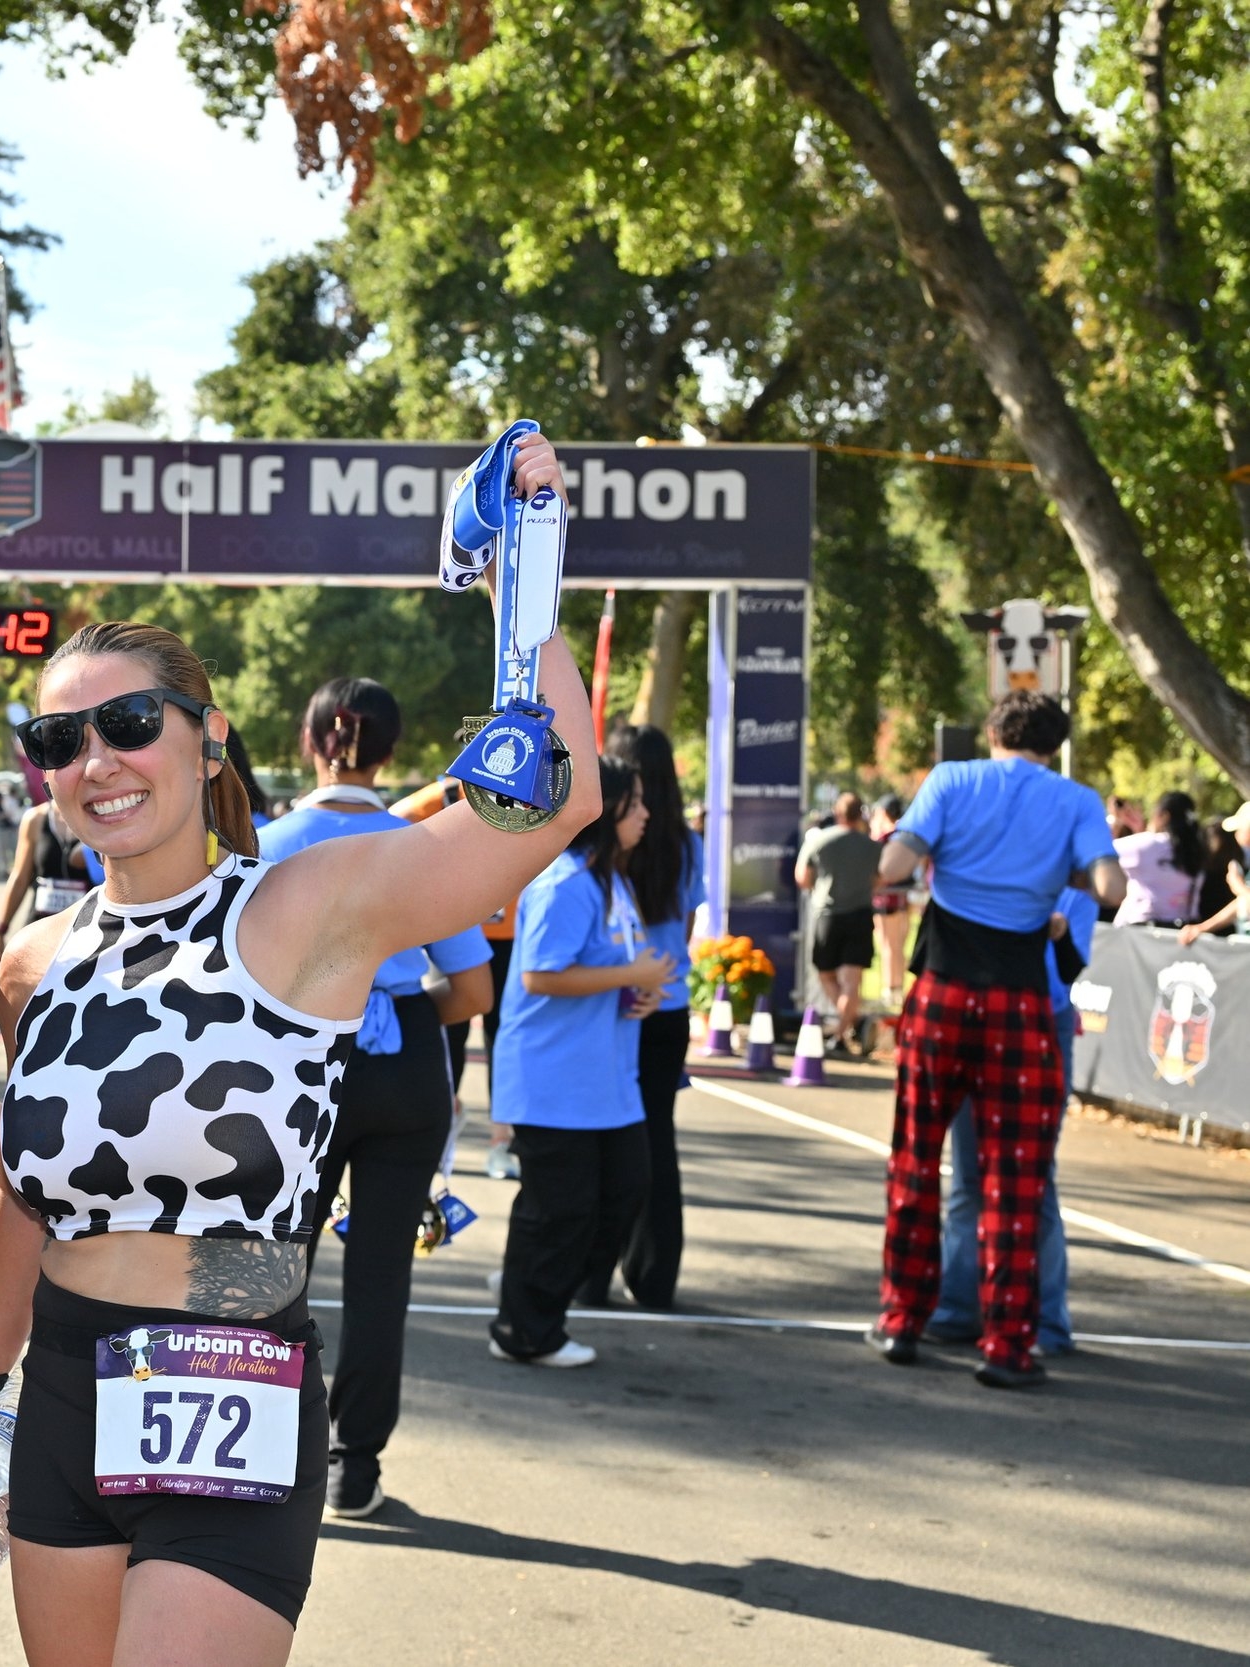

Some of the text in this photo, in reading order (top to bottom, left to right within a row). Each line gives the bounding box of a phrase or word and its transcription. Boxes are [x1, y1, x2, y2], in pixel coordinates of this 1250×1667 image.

[100, 454, 284, 515] Half
[113, 537, 178, 560] MALL
[485, 727, 509, 739] Urban
[510, 727, 526, 738] Cow
[196, 1328, 225, 1336] Sacramento,
[237, 1331, 256, 1339] October
[168, 1333, 291, 1362] Urban Cow
[187, 1354, 278, 1376] Half Marathon
[140, 1391, 252, 1470] 572
[156, 1478, 191, 1493] Celebrating
[193, 1481, 204, 1490] 20
[206, 1482, 225, 1494] Years
